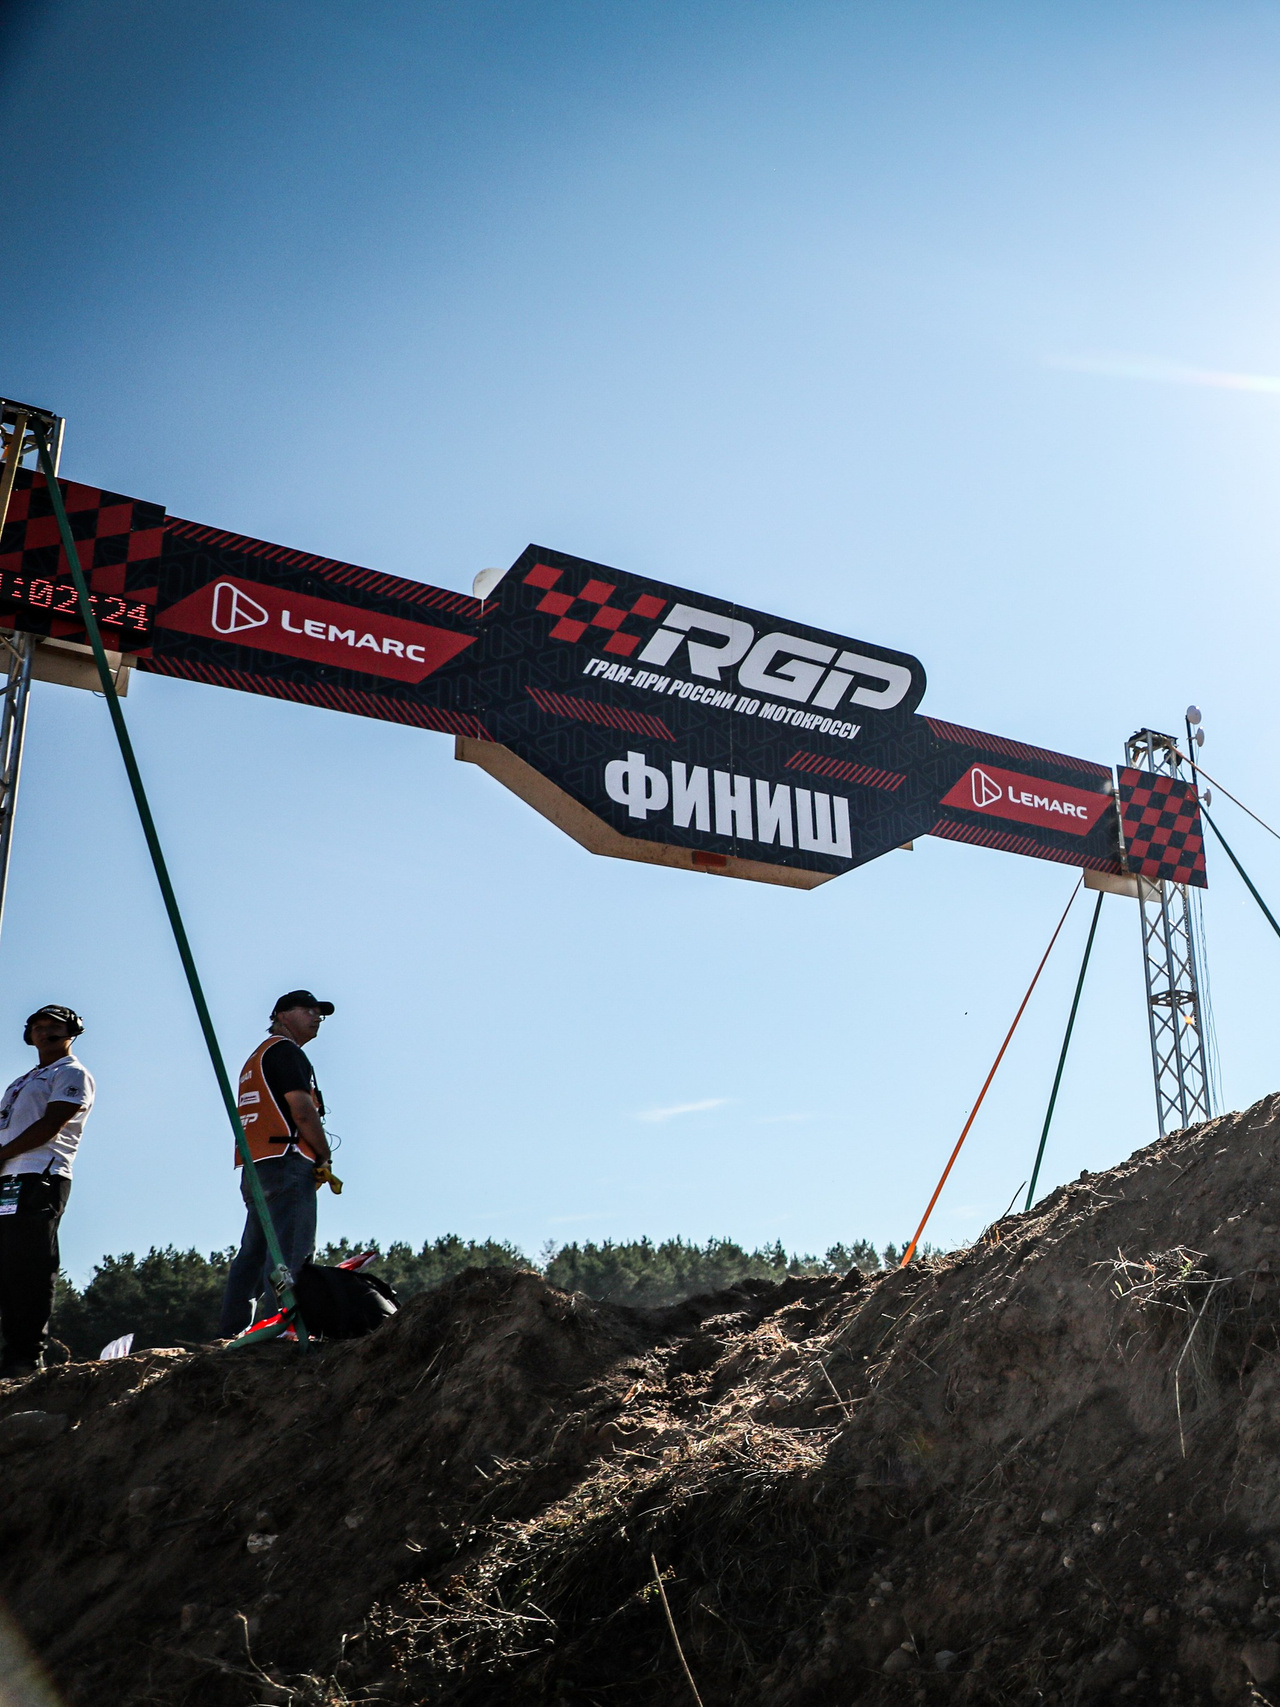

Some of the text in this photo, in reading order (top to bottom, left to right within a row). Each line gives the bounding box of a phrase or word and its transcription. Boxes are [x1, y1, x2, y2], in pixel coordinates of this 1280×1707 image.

[0, 573, 149, 631] :02:24
[281, 609, 426, 663] LEMARC
[637, 602, 912, 711] RGP
[583, 657, 861, 740] ГРАН-ПРИ РОССИИ ПО МОТОКРОССУ
[604, 750, 853, 859] ФИНИШ
[1008, 785, 1088, 820] LEMARC
